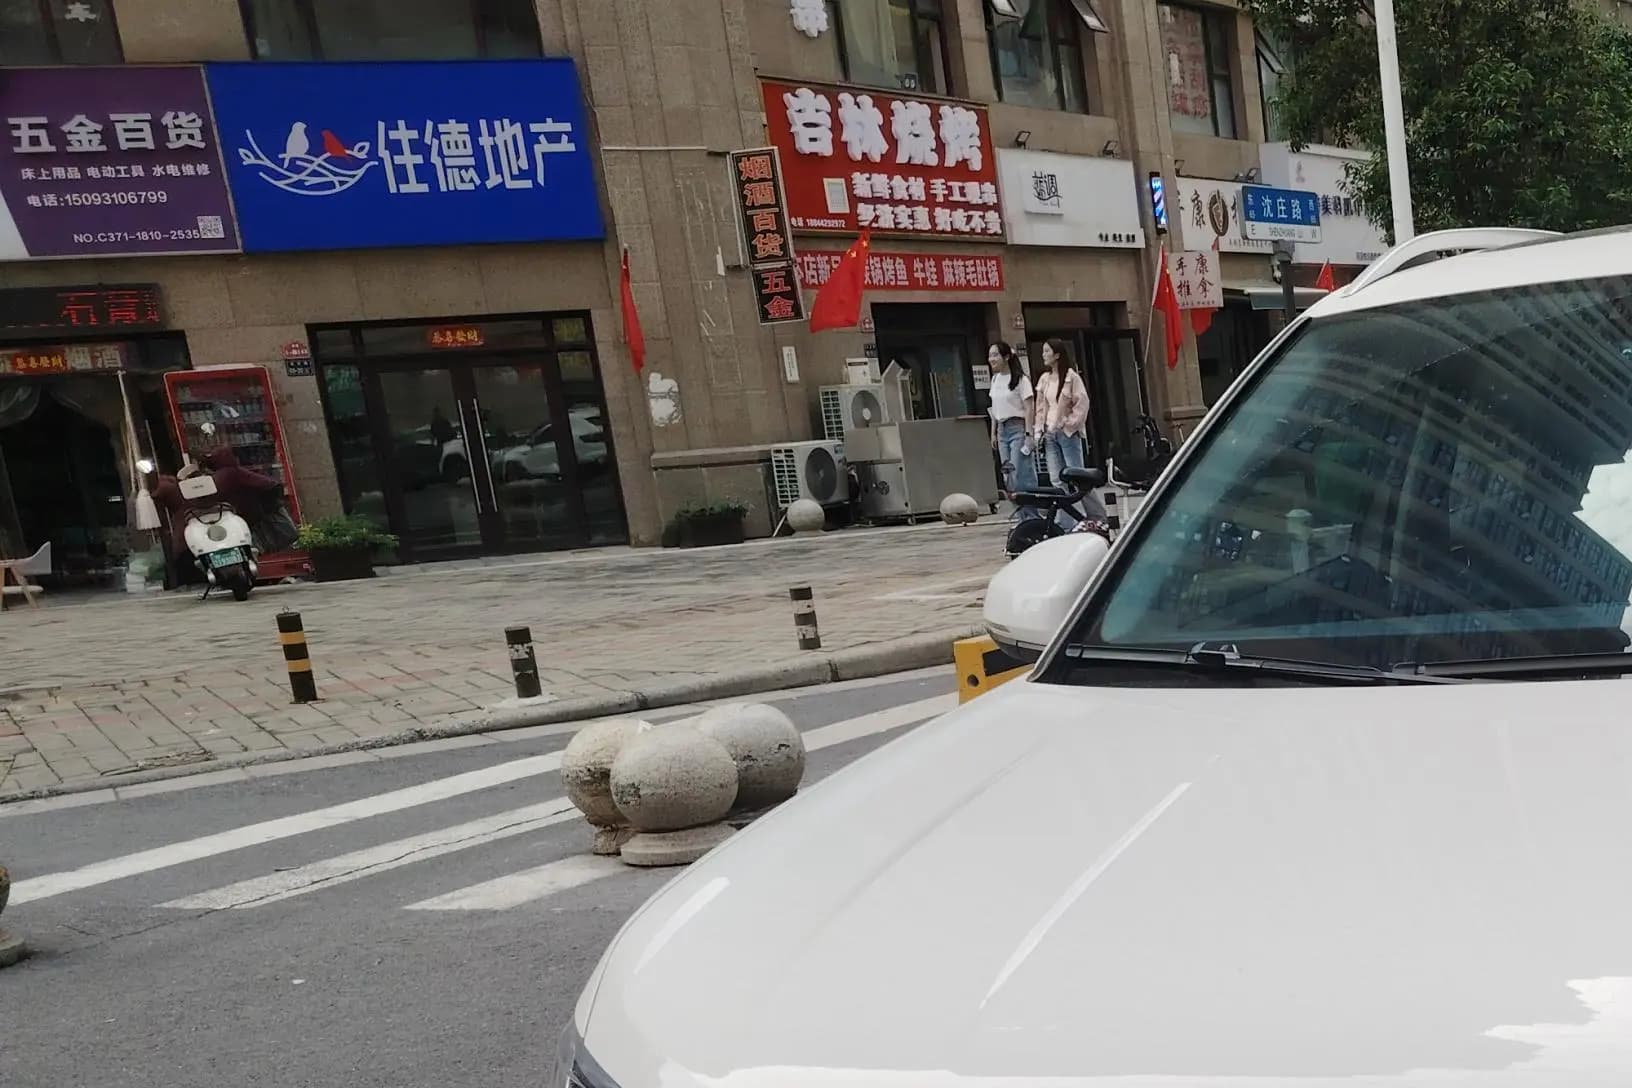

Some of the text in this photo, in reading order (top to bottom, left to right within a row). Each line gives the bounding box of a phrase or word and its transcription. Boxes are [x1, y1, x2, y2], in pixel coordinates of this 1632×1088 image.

[7, 111, 206, 153] 五金百货
[21, 163, 211, 180] 床上用品 电动工具 水电维修
[738, 155, 784, 258] 烟酒百货
[1261, 194, 1303, 221] 沈庄路
[913, 257, 939, 287] 牛蛙
[942, 258, 999, 288] 麻辣毛肚锅
[762, 271, 795, 319] 五金
